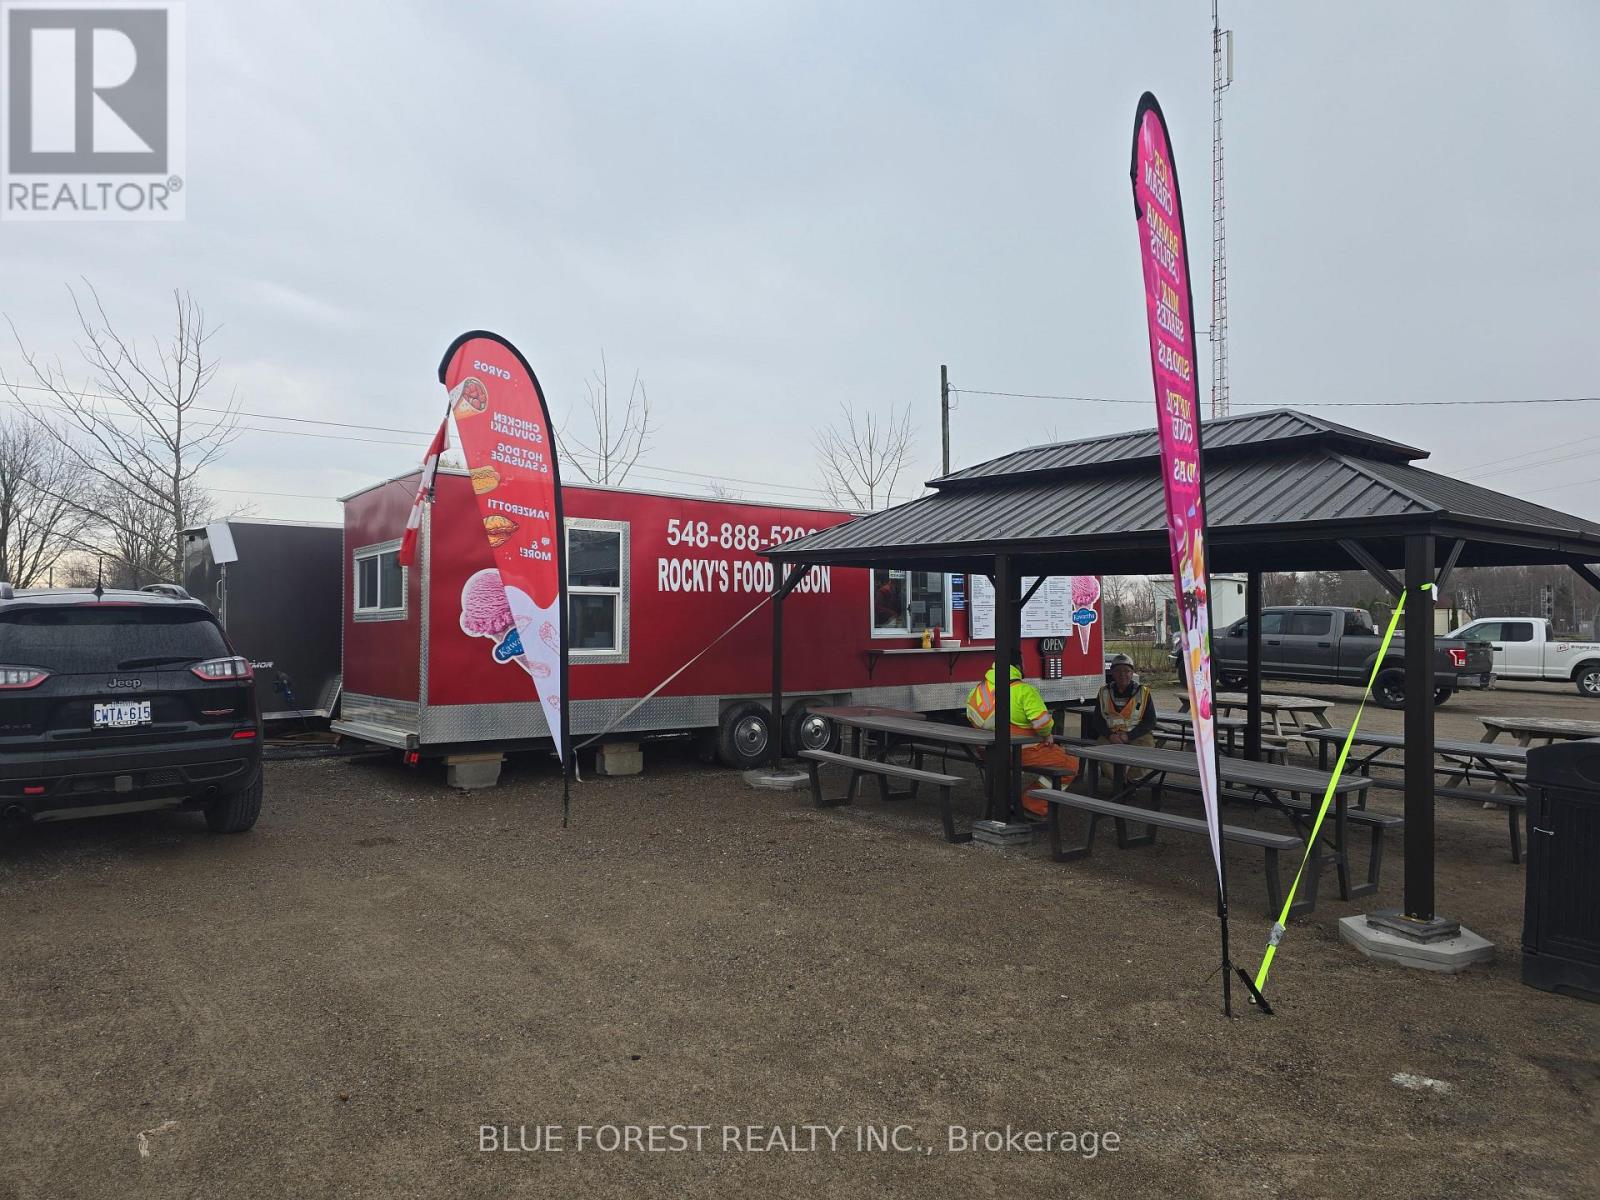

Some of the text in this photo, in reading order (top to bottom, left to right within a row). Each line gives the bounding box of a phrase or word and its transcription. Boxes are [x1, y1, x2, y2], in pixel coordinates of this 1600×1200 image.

[658, 558, 831, 593] ROCKY'S FOOD WGON
[1043, 638, 1063, 650] OPEN
[108, 678, 142, 689] Jeep
